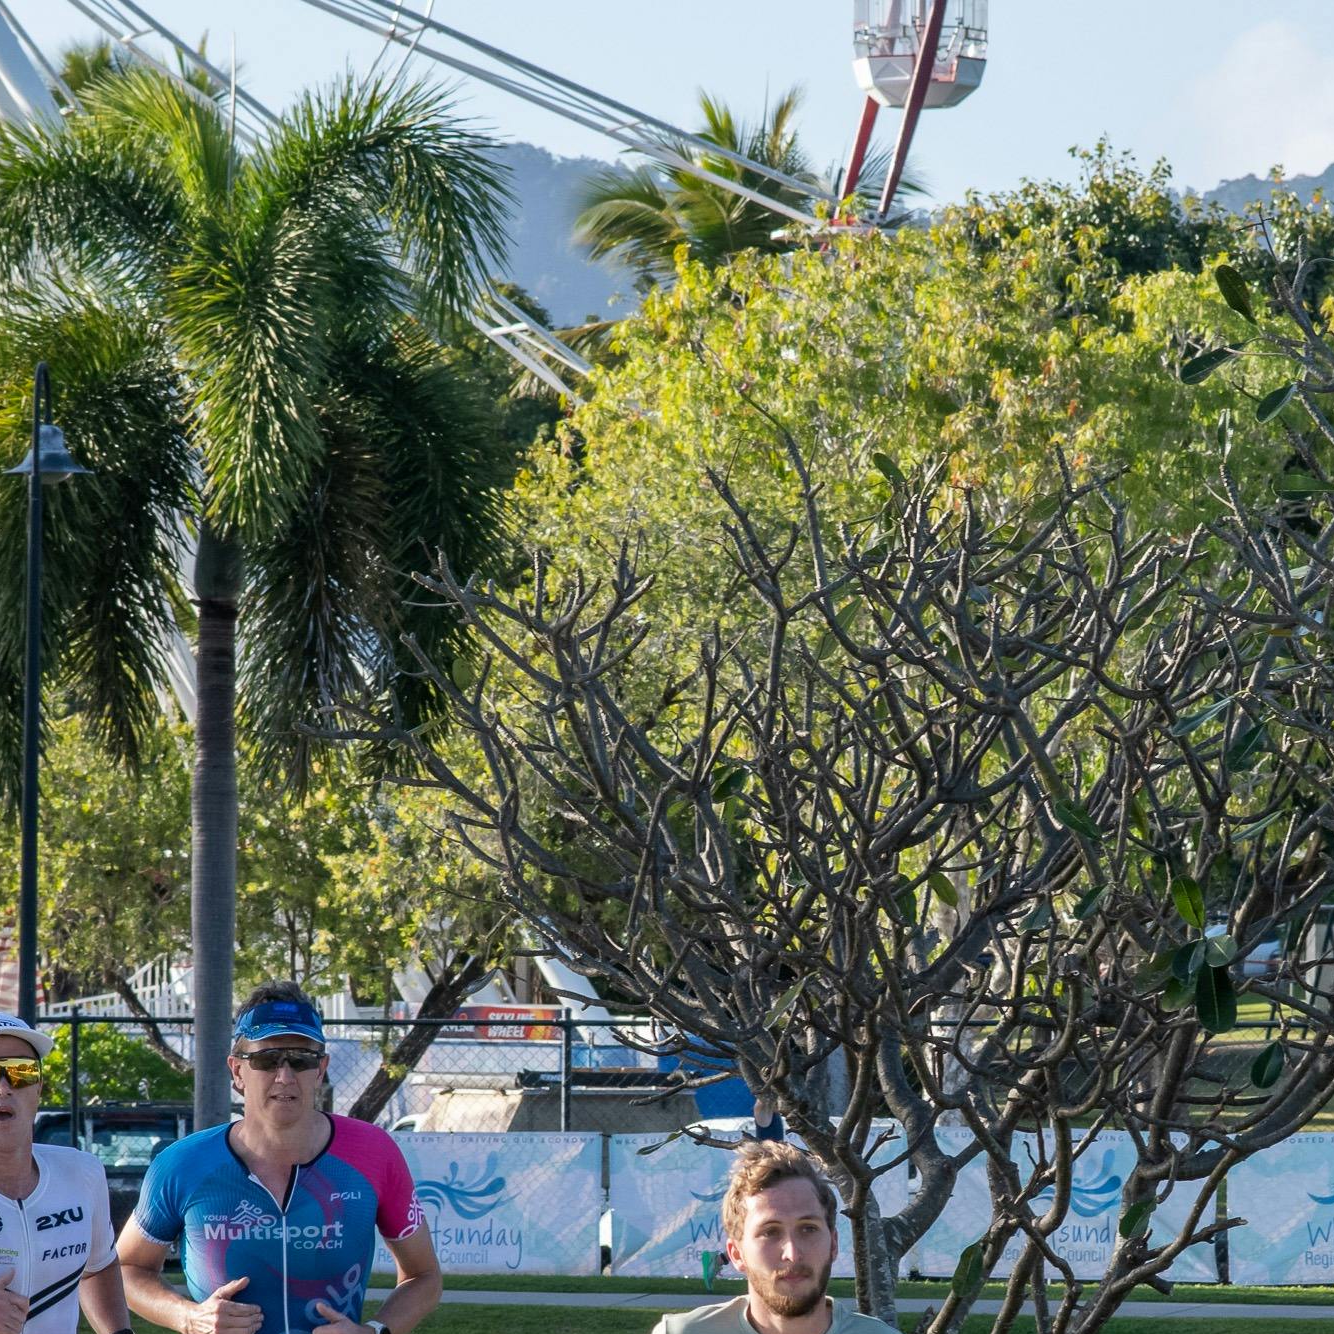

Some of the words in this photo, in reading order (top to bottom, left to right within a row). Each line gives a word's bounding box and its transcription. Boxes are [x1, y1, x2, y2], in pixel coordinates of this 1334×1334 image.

[35, 1206, 84, 1232] 2XU
[202, 1214, 228, 1222] YOUR
[203, 1220, 344, 1244] Multisport
[42, 1242, 87, 1261] FACTOR
[293, 1239, 343, 1250] COACH
[430, 1215, 523, 1269] tsunday
[441, 1250, 488, 1265] Council
